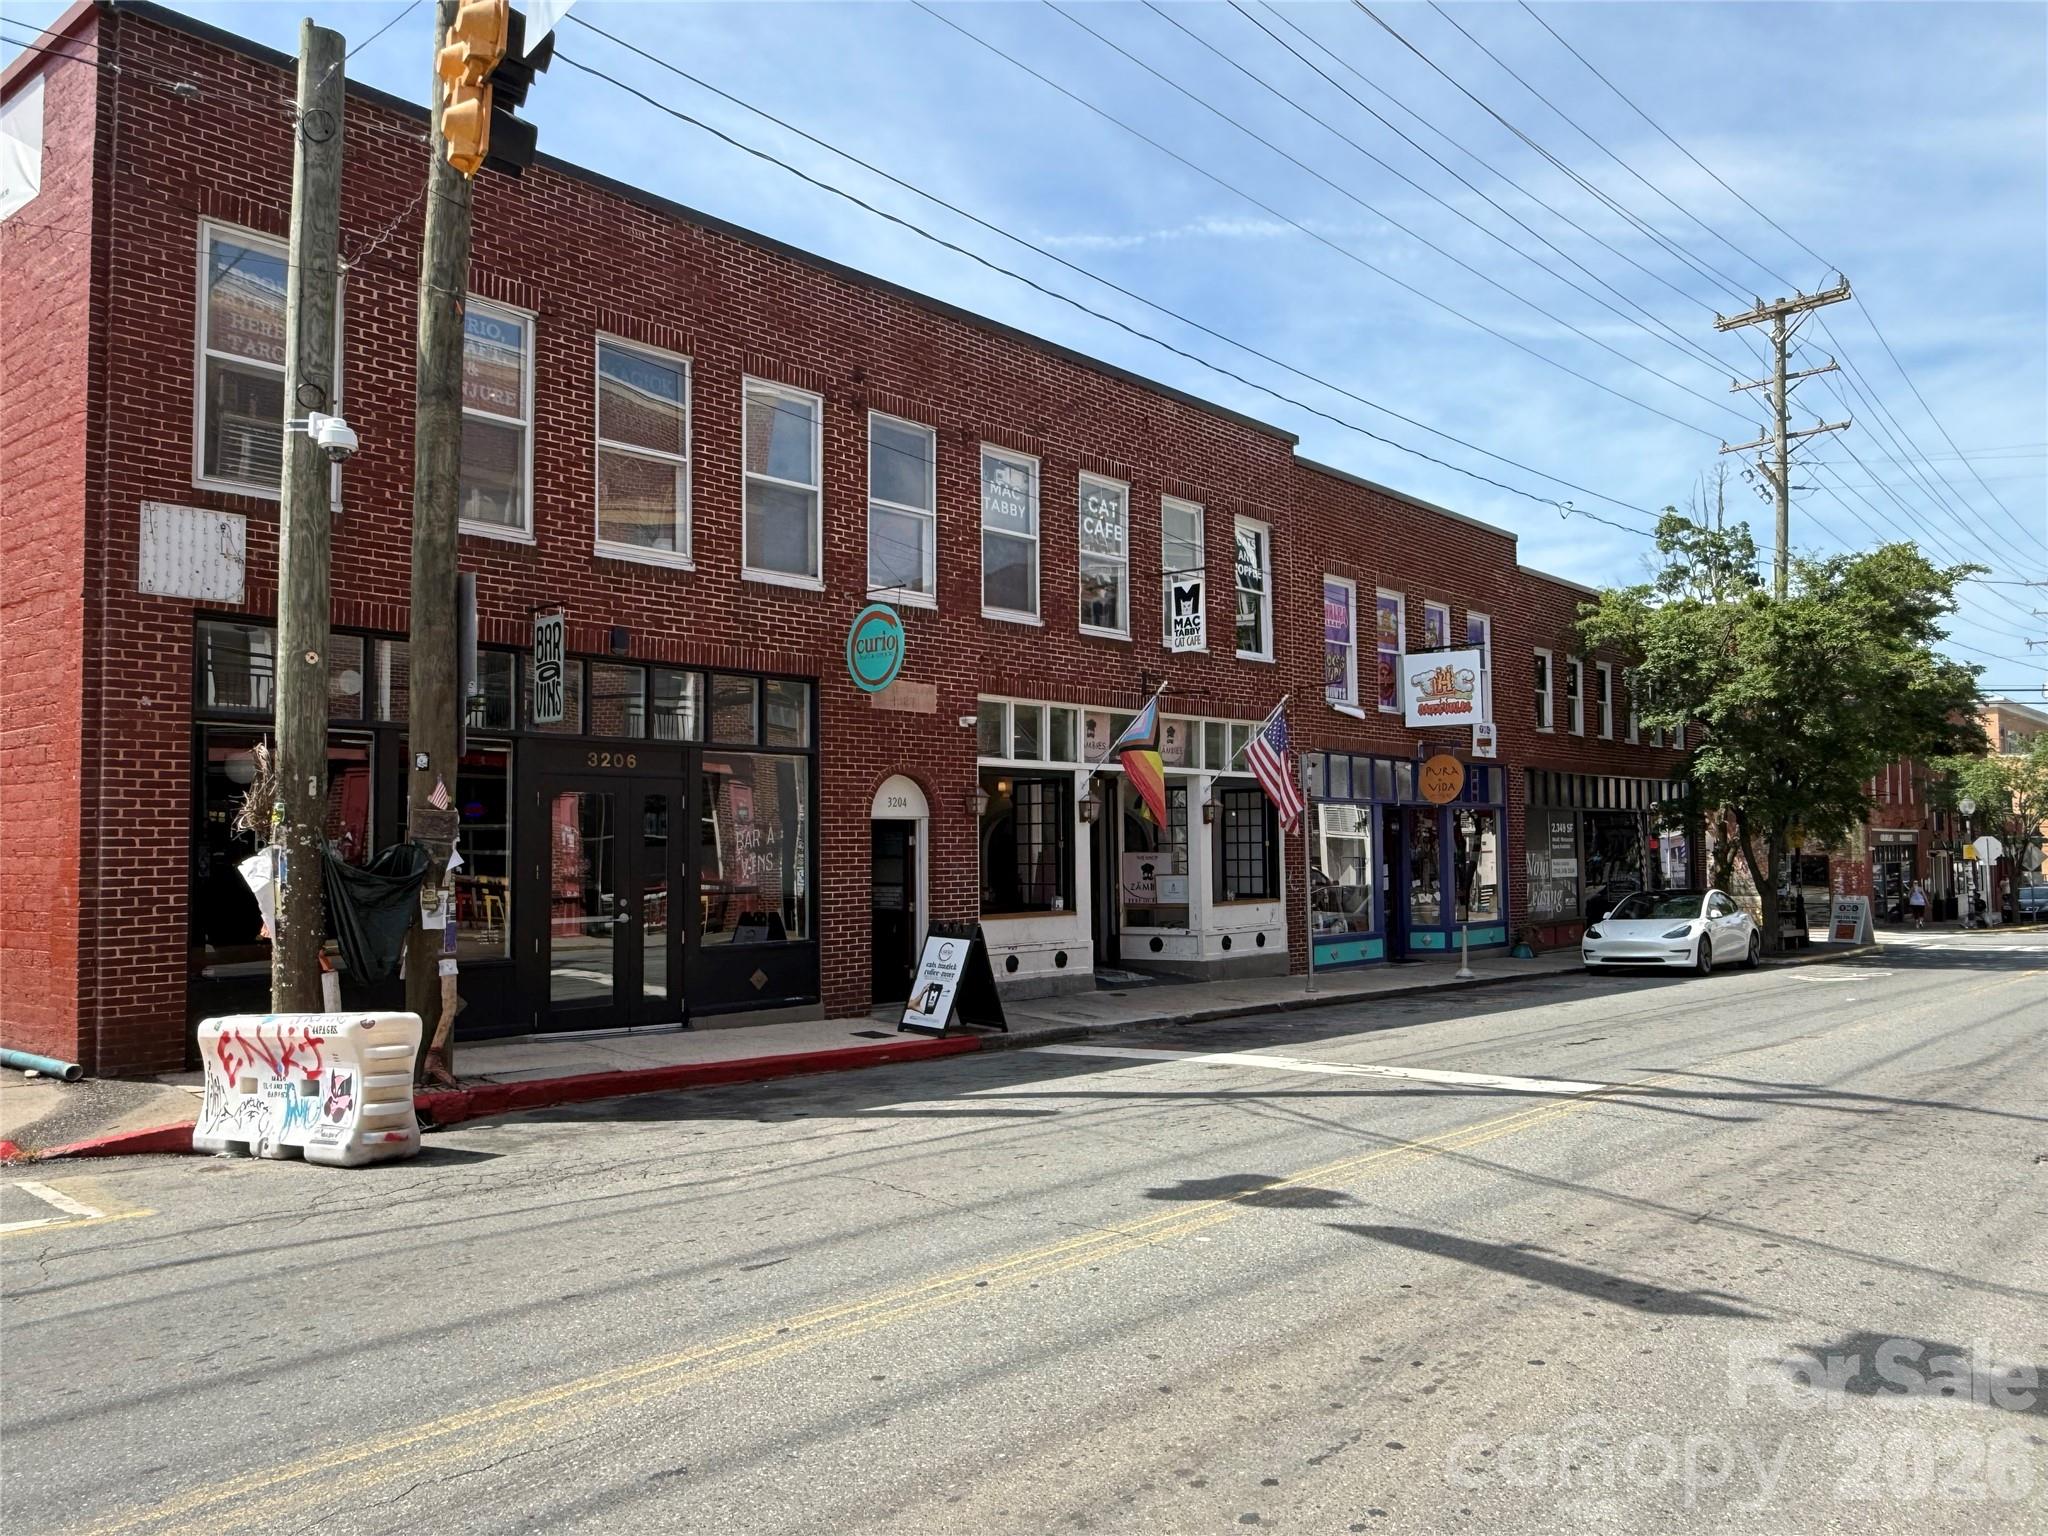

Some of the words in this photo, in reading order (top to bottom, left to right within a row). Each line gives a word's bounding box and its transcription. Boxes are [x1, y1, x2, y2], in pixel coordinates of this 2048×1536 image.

[465, 318, 505, 342] RIO,
[990, 481, 1020, 500] MAC
[984, 497, 1026, 518] TABBY
[1088, 496, 1117, 518] CAT
[1084, 517, 1122, 541] CAFE
[1174, 615, 1201, 630] MAC
[1175, 627, 1201, 637] TABBY
[536, 622, 561, 663] BAR
[857, 630, 896, 654] curio
[1175, 637, 1185, 648] CAT
[1187, 634, 1201, 647] CAFE
[536, 680, 561, 718] VINS
[587, 752, 637, 768] 3206
[1425, 767, 1459, 777] PURA
[1428, 783, 1455, 793] VIDA
[888, 796, 907, 808] 3204
[735, 829, 760, 850] BAR
[767, 824, 775, 844] A
[1526, 853, 1549, 878] Now
[1526, 882, 1563, 913] Leasing
